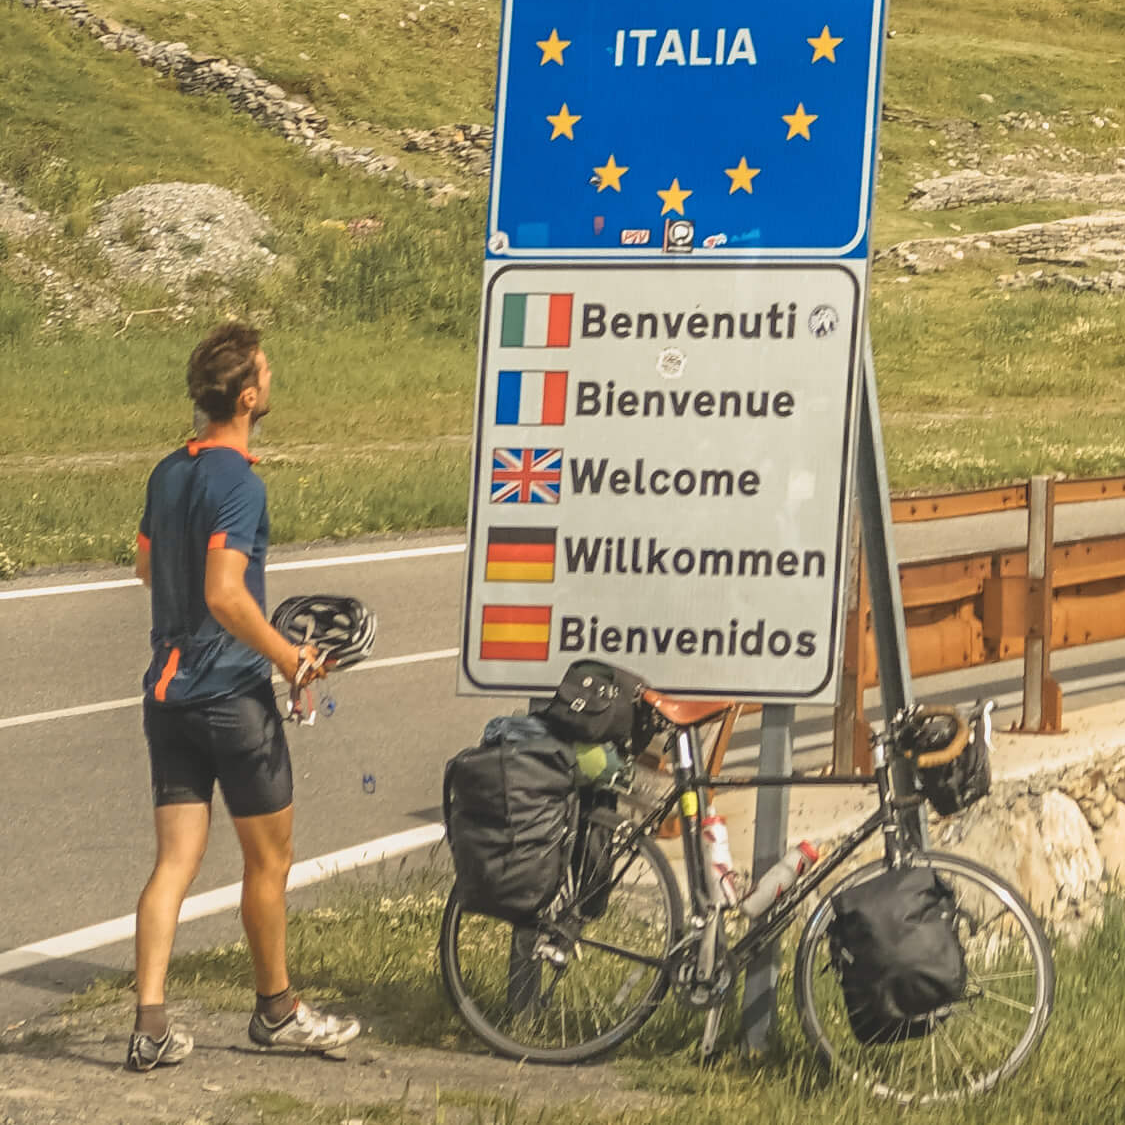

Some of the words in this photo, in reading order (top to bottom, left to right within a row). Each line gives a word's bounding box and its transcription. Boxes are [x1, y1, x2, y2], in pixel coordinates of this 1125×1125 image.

[614, 27, 758, 67] ITALIA
[581, 302, 797, 340] Benvenuti
[575, 380, 795, 418] Bienvenue
[569, 458, 761, 497] Welcome
[563, 536, 827, 578] Willkommen
[558, 615, 817, 658] Bienvenidos
